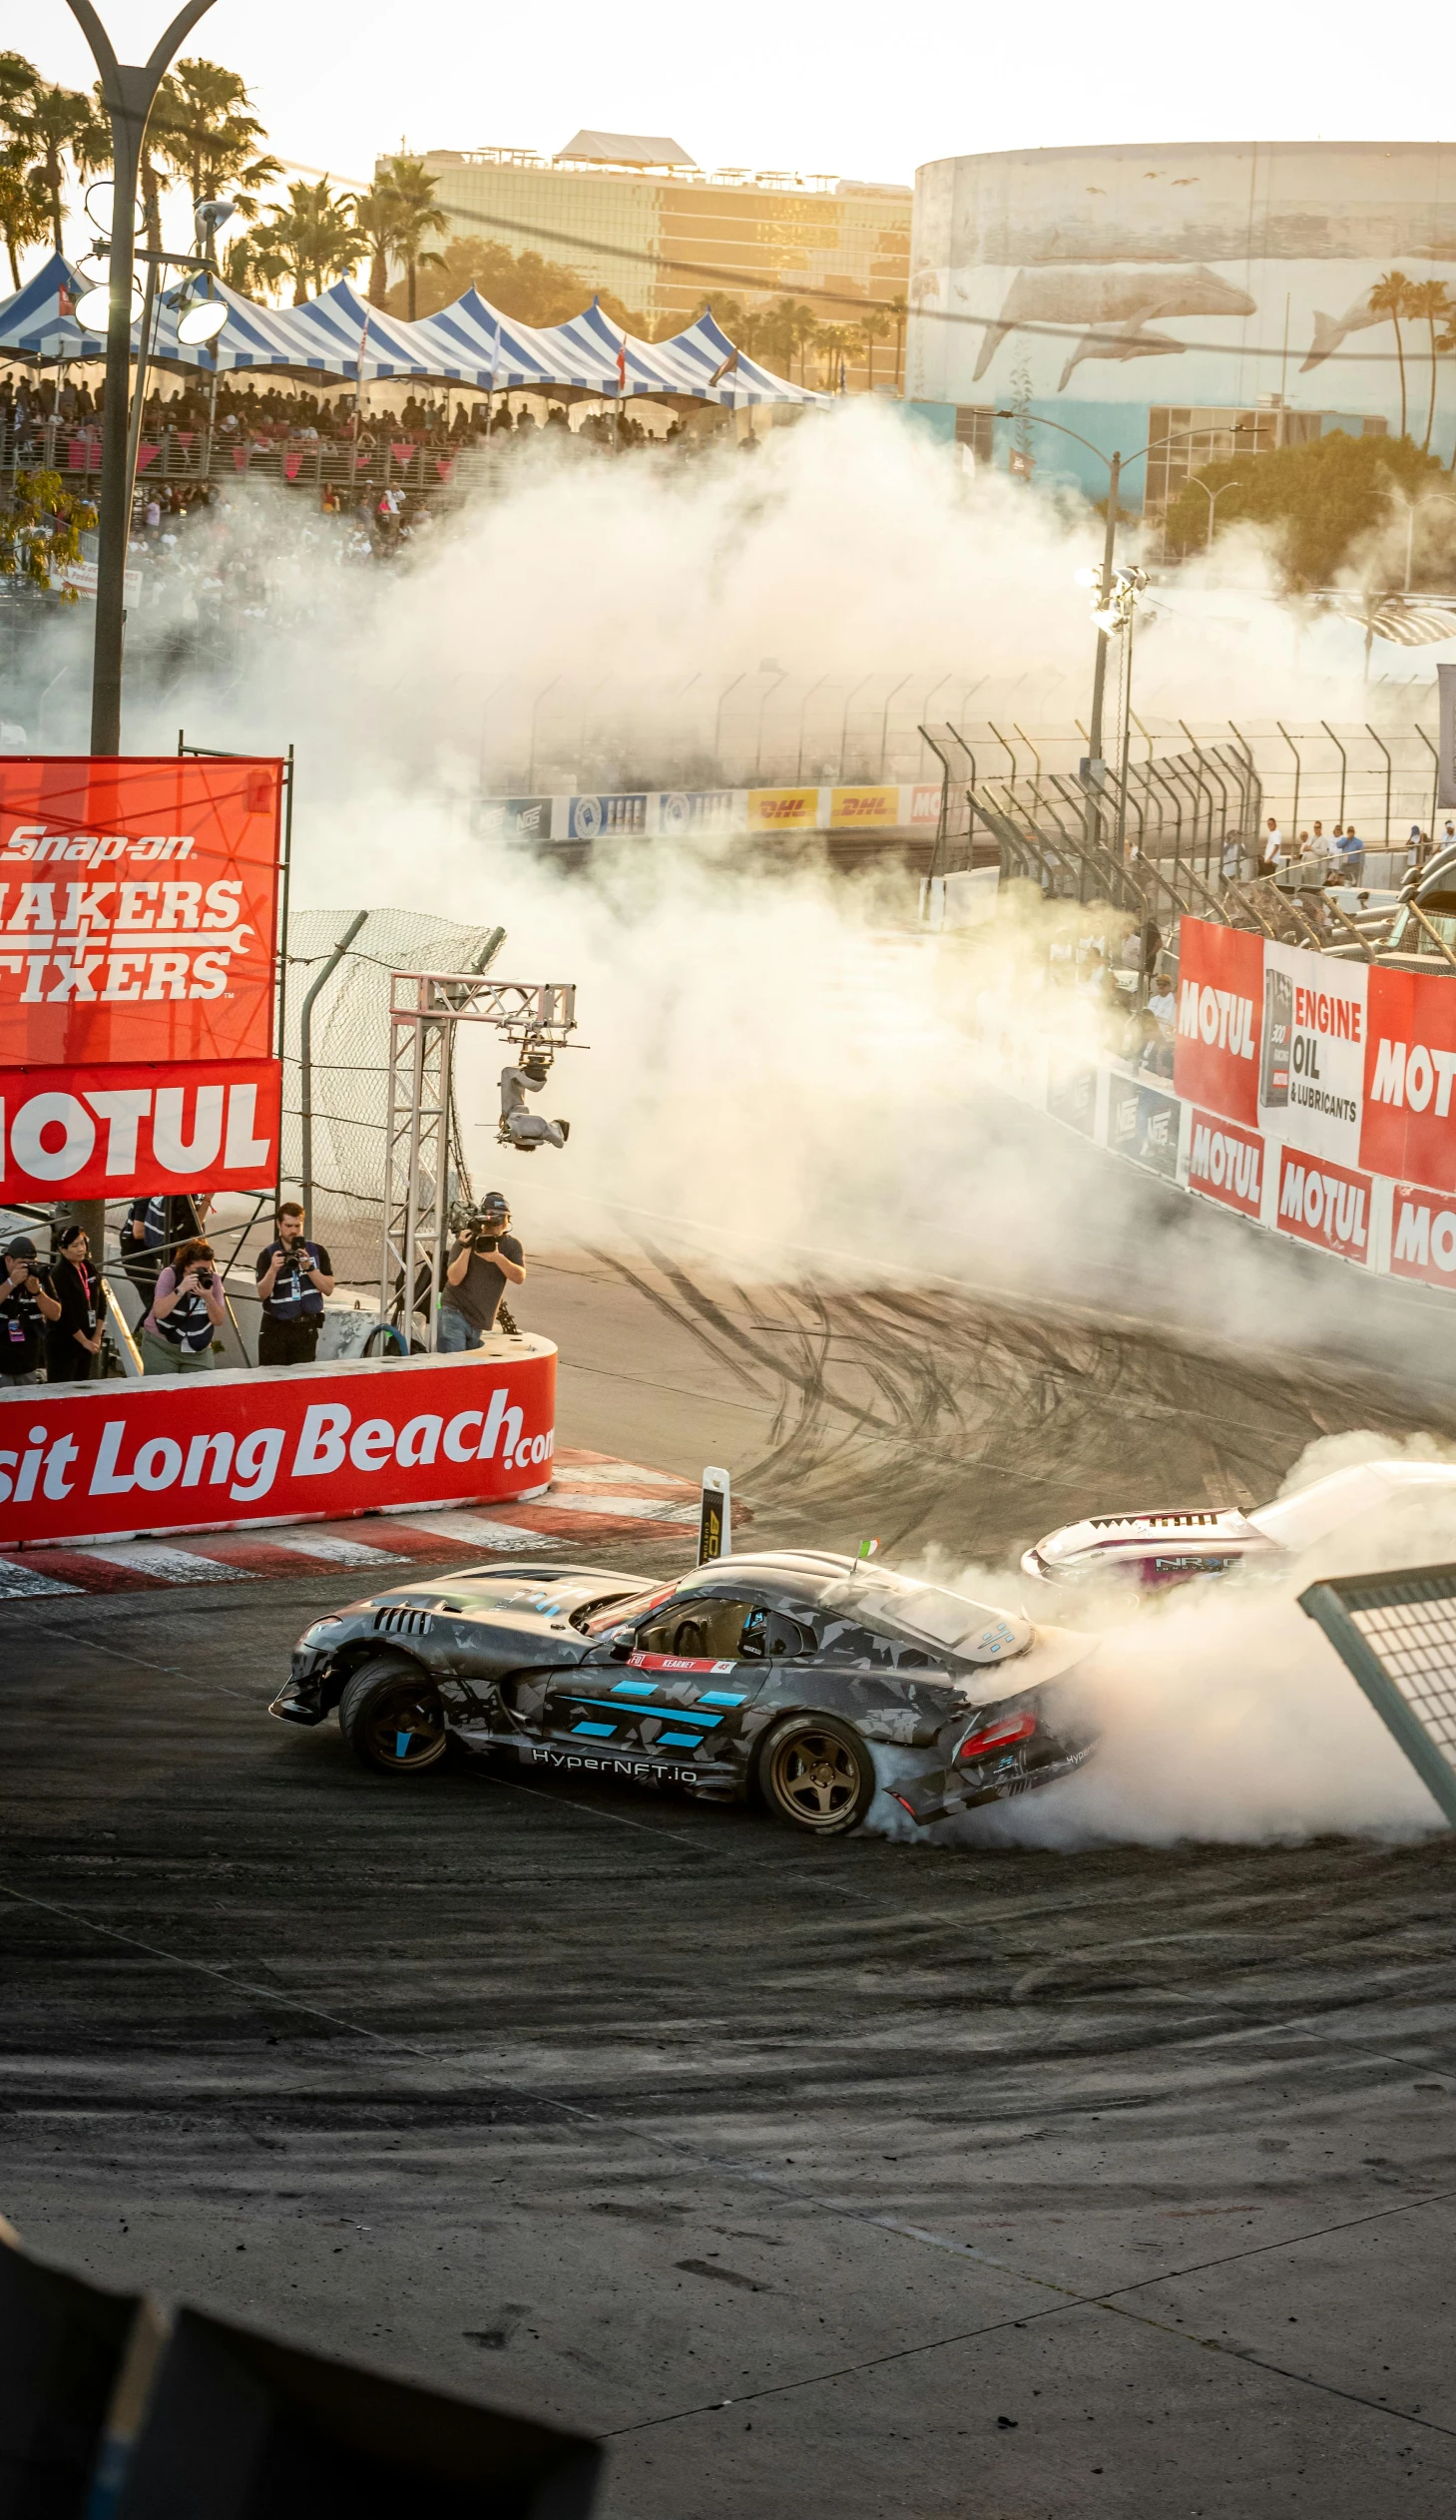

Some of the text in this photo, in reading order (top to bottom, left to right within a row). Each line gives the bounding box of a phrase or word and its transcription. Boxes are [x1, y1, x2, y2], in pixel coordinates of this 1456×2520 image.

[516, 804, 543, 831] NOS
[758, 799, 806, 818] DHL
[840, 797, 887, 816] DHL
[0, 879, 243, 931] AKERS
[1179, 979, 1255, 1061] MOTUL
[1295, 987, 1361, 1043] ENGINE
[1293, 1035, 1320, 1080] OIL
[1291, 1082, 1356, 1123] & LUBRICANTS
[0, 1084, 271, 1182] OTUL
[1191, 1124, 1261, 1204] MOTUL
[1279, 1162, 1367, 1248] MOTUL
[88, 1420, 286, 1502] Long
[662, 1659, 697, 1669] KEARNEY
[532, 1749, 698, 1782] HyperNFT.io
